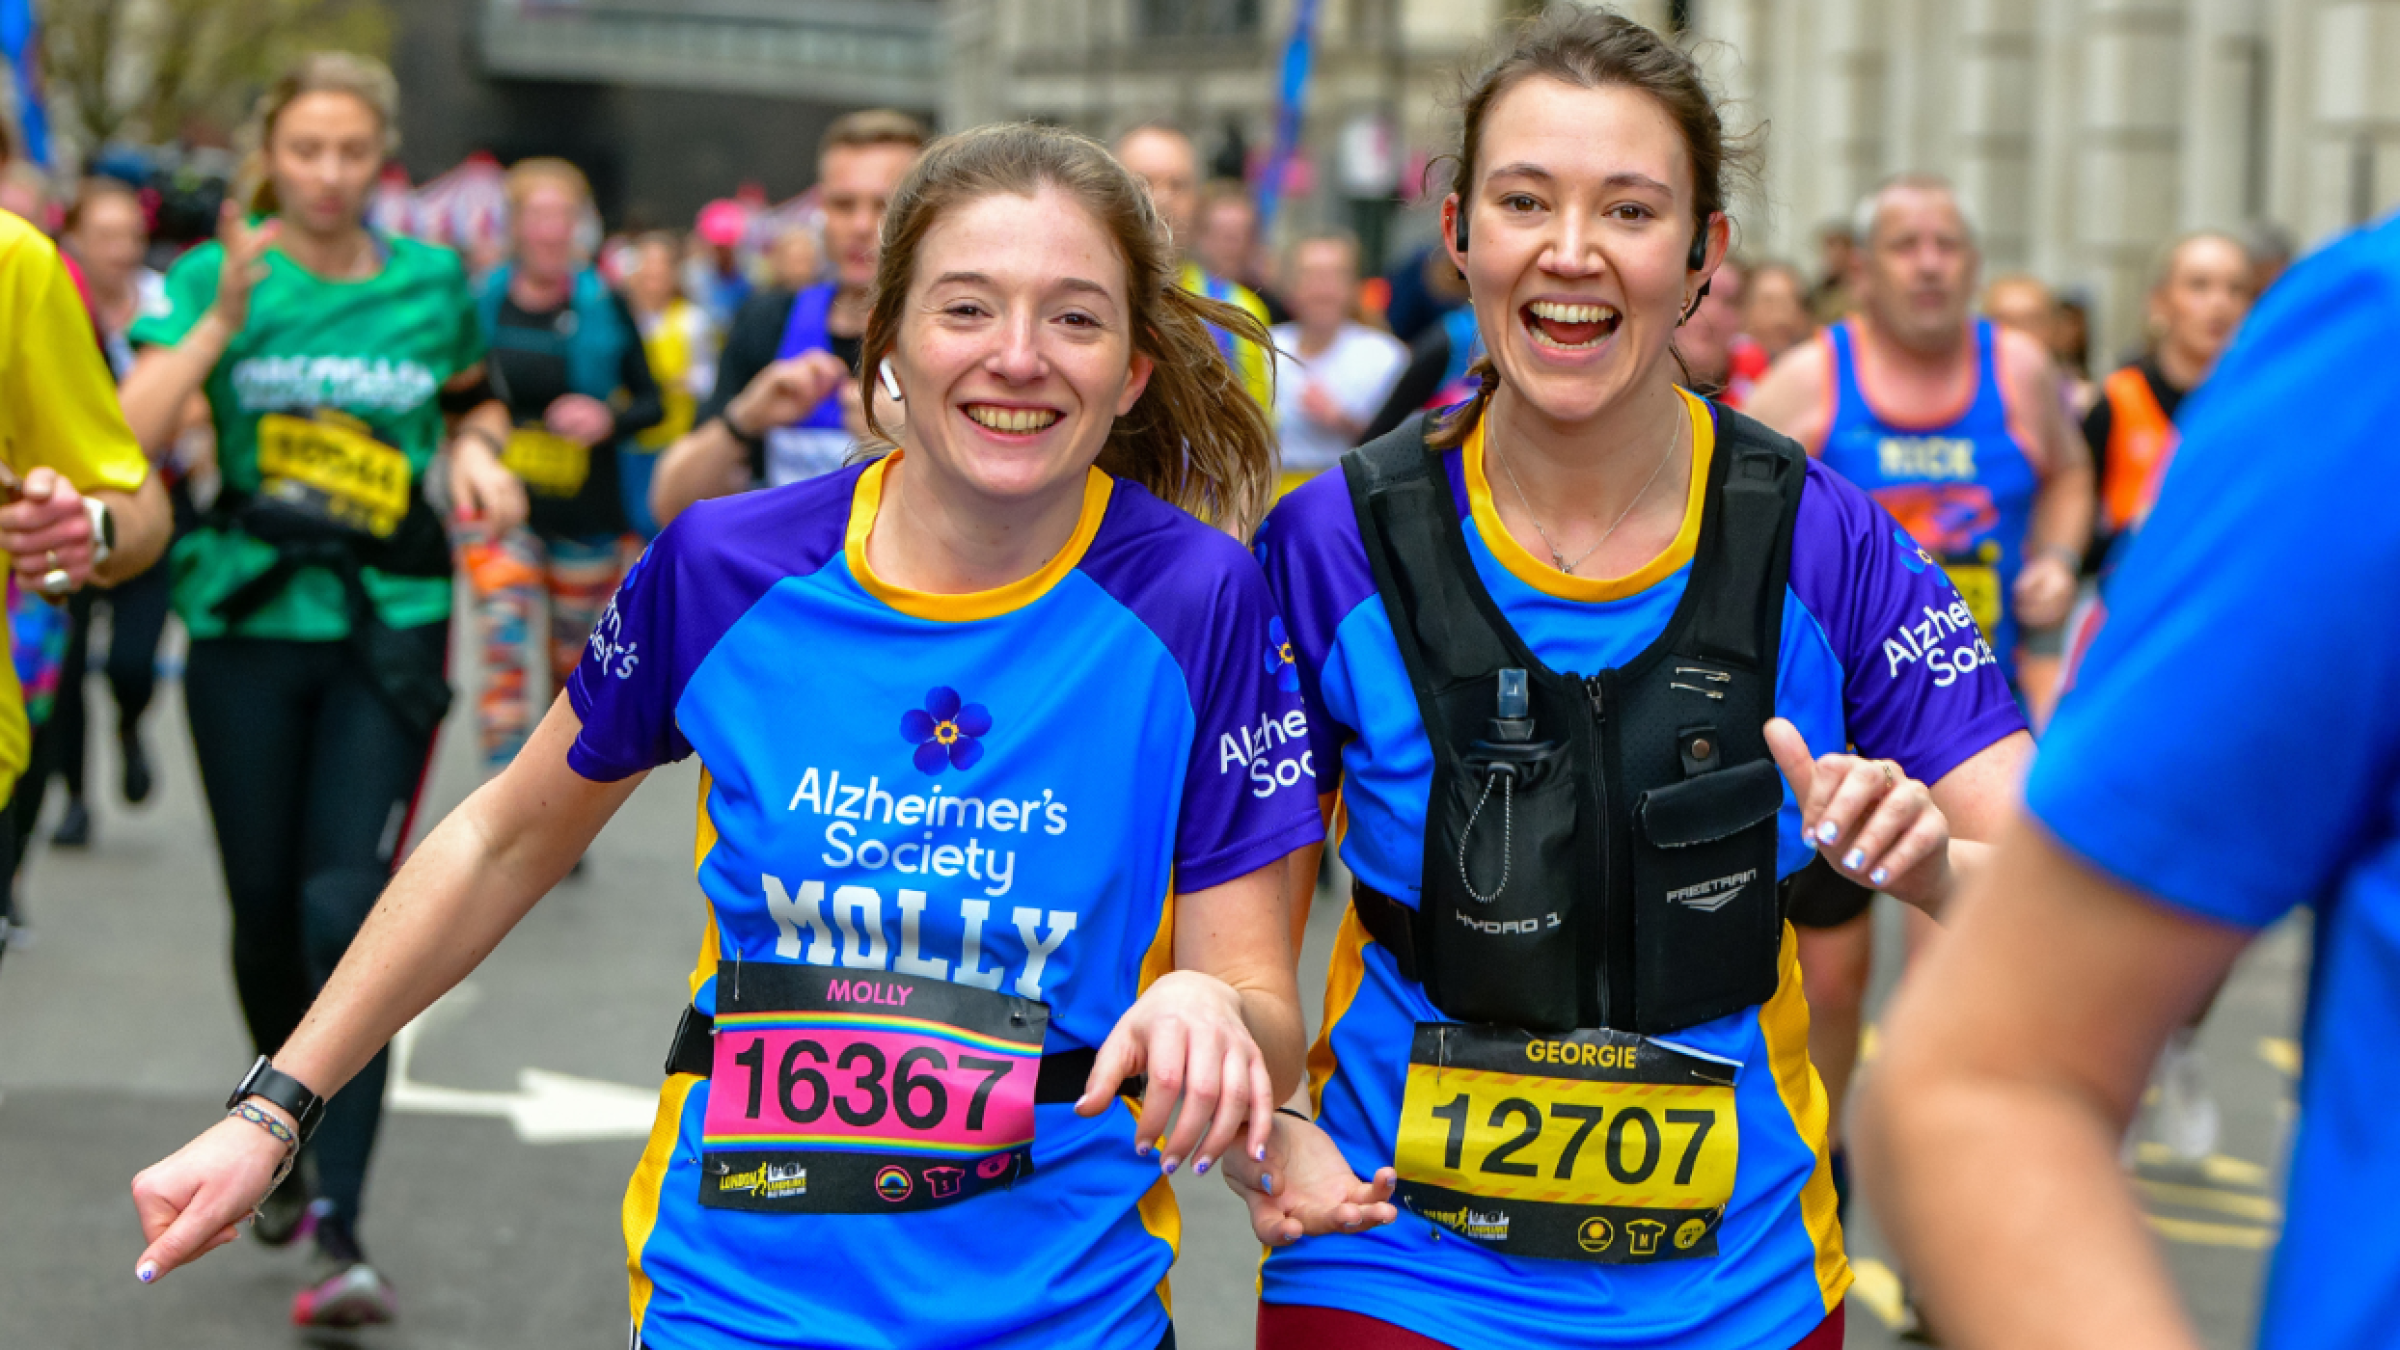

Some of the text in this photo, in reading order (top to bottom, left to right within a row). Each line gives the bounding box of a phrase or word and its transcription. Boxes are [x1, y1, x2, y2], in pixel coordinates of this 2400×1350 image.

[787, 766, 1069, 836] Alzheimer's
[1250, 749, 1317, 798] Soc
[821, 820, 1016, 897] Society
[761, 872, 1078, 1002] MOLLY
[1546, 910, 1562, 929] 1
[826, 978, 914, 1007] MOLLY
[734, 1036, 1015, 1132] 16367
[1525, 1038, 1638, 1070] GEORGIE
[1430, 1092, 1716, 1186] 12707
